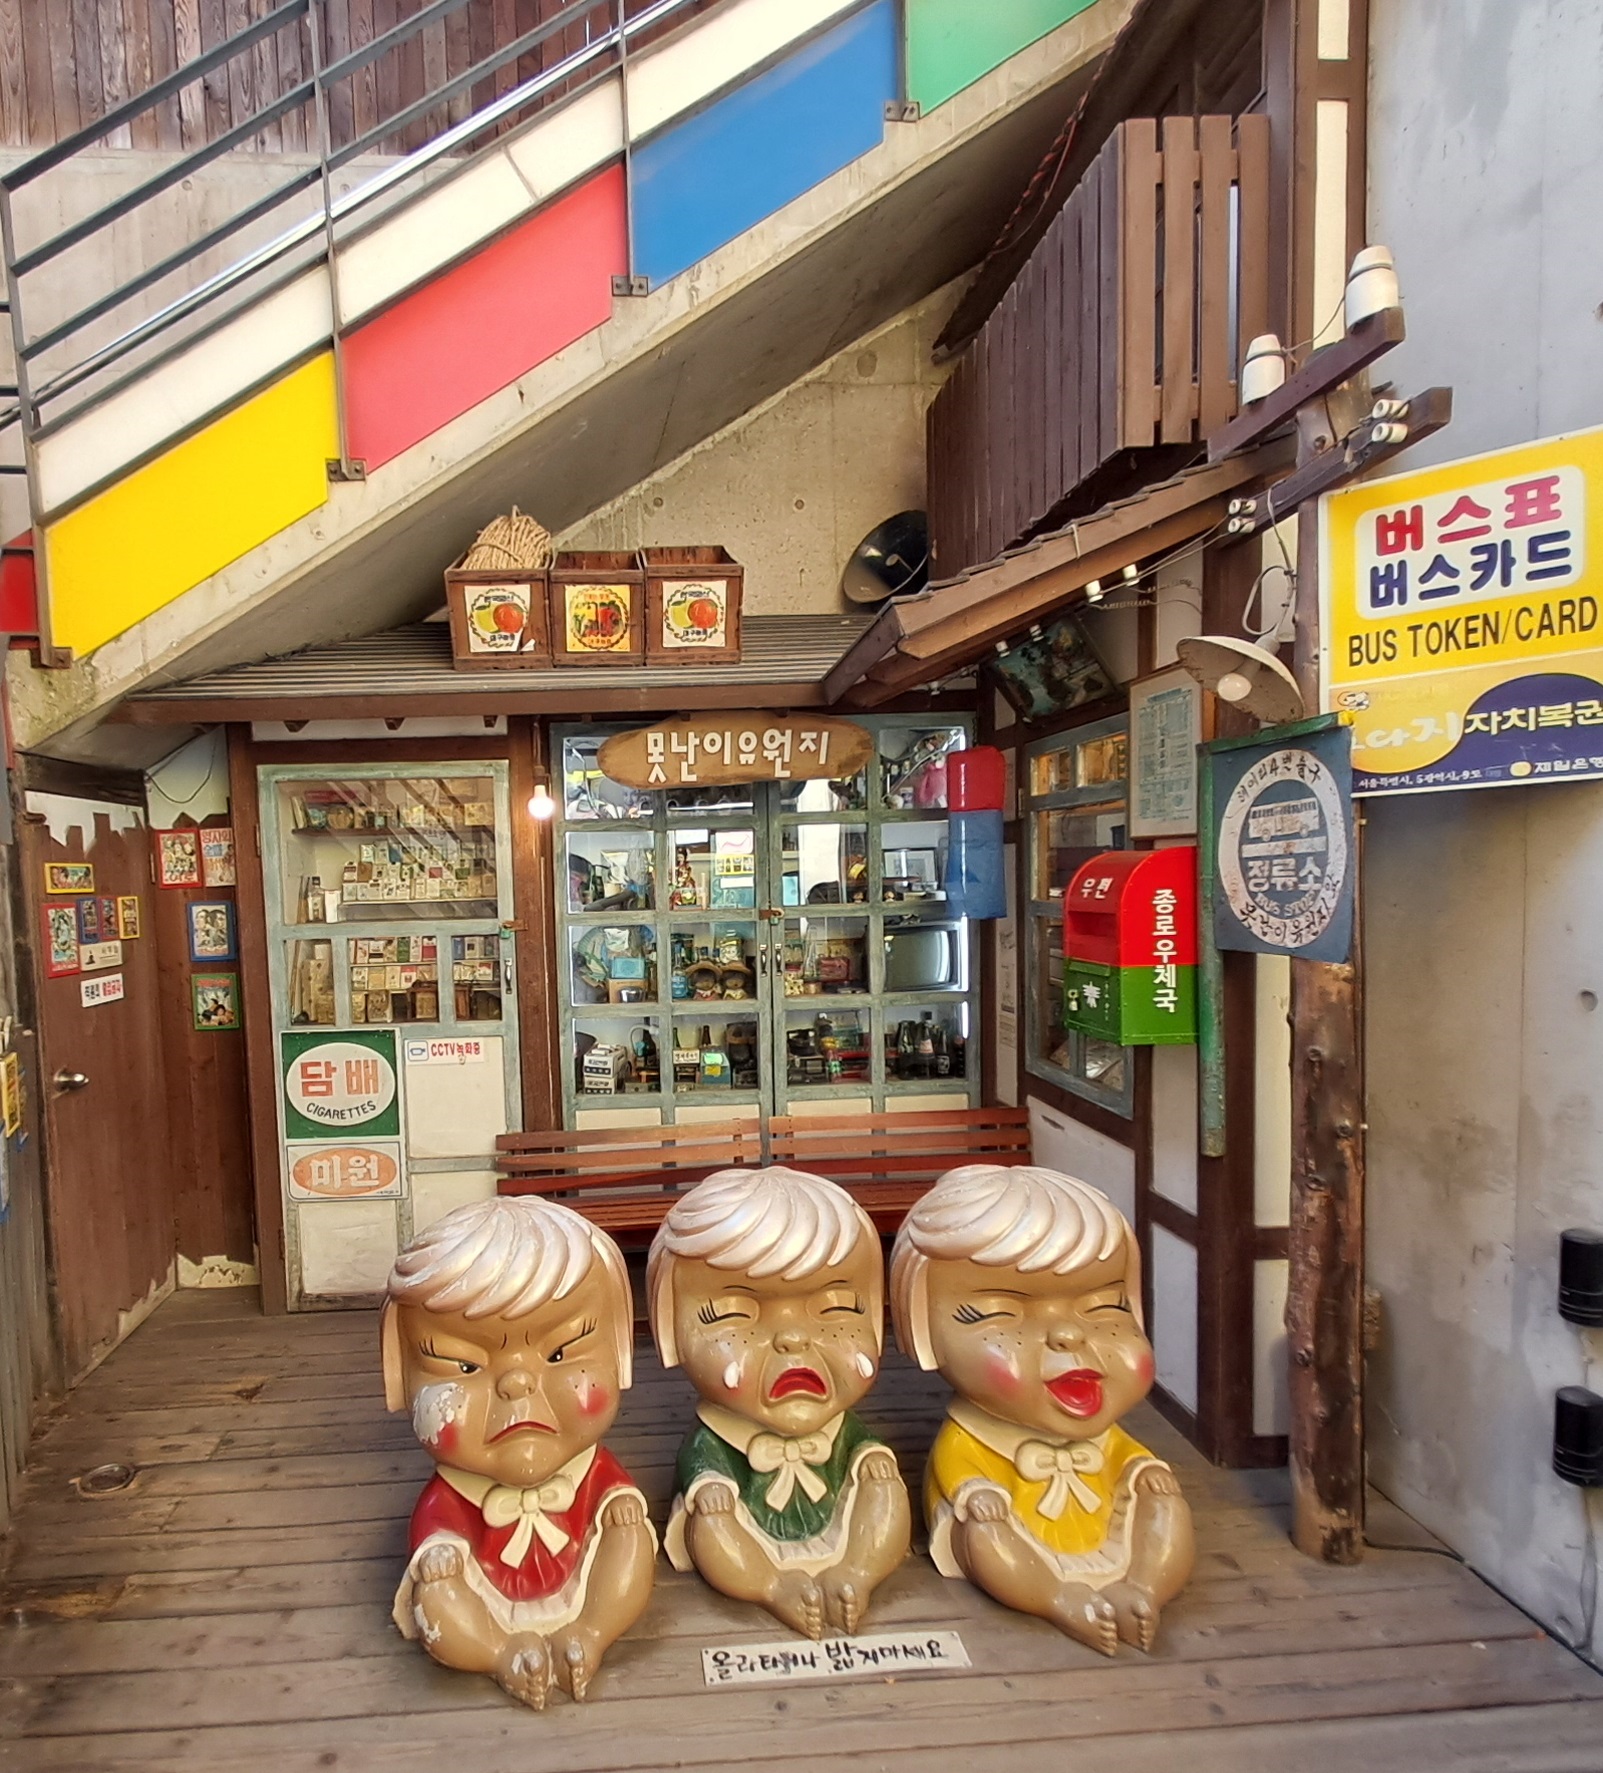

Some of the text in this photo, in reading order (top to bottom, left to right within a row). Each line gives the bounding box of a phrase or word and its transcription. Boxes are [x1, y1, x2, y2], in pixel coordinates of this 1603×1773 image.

[1376, 475, 1562, 556] 버스표
[1370, 530, 1572, 609] 버스카드
[1348, 595, 1598, 667] BUS TOKEN/CARD
[1464, 700, 1603, 735] 자치복권
[646, 728, 830, 784] 못난이유원지
[1081, 877, 1114, 899] 우편
[1248, 856, 1322, 892] 정류소
[1255, 892, 1281, 915] BUS
[1152, 889, 1178, 1013] 종로우체국
[300, 1058, 379, 1097] 담배
[306, 1100, 377, 1120] CIGARETTES
[310, 1153, 380, 1189] 미원
